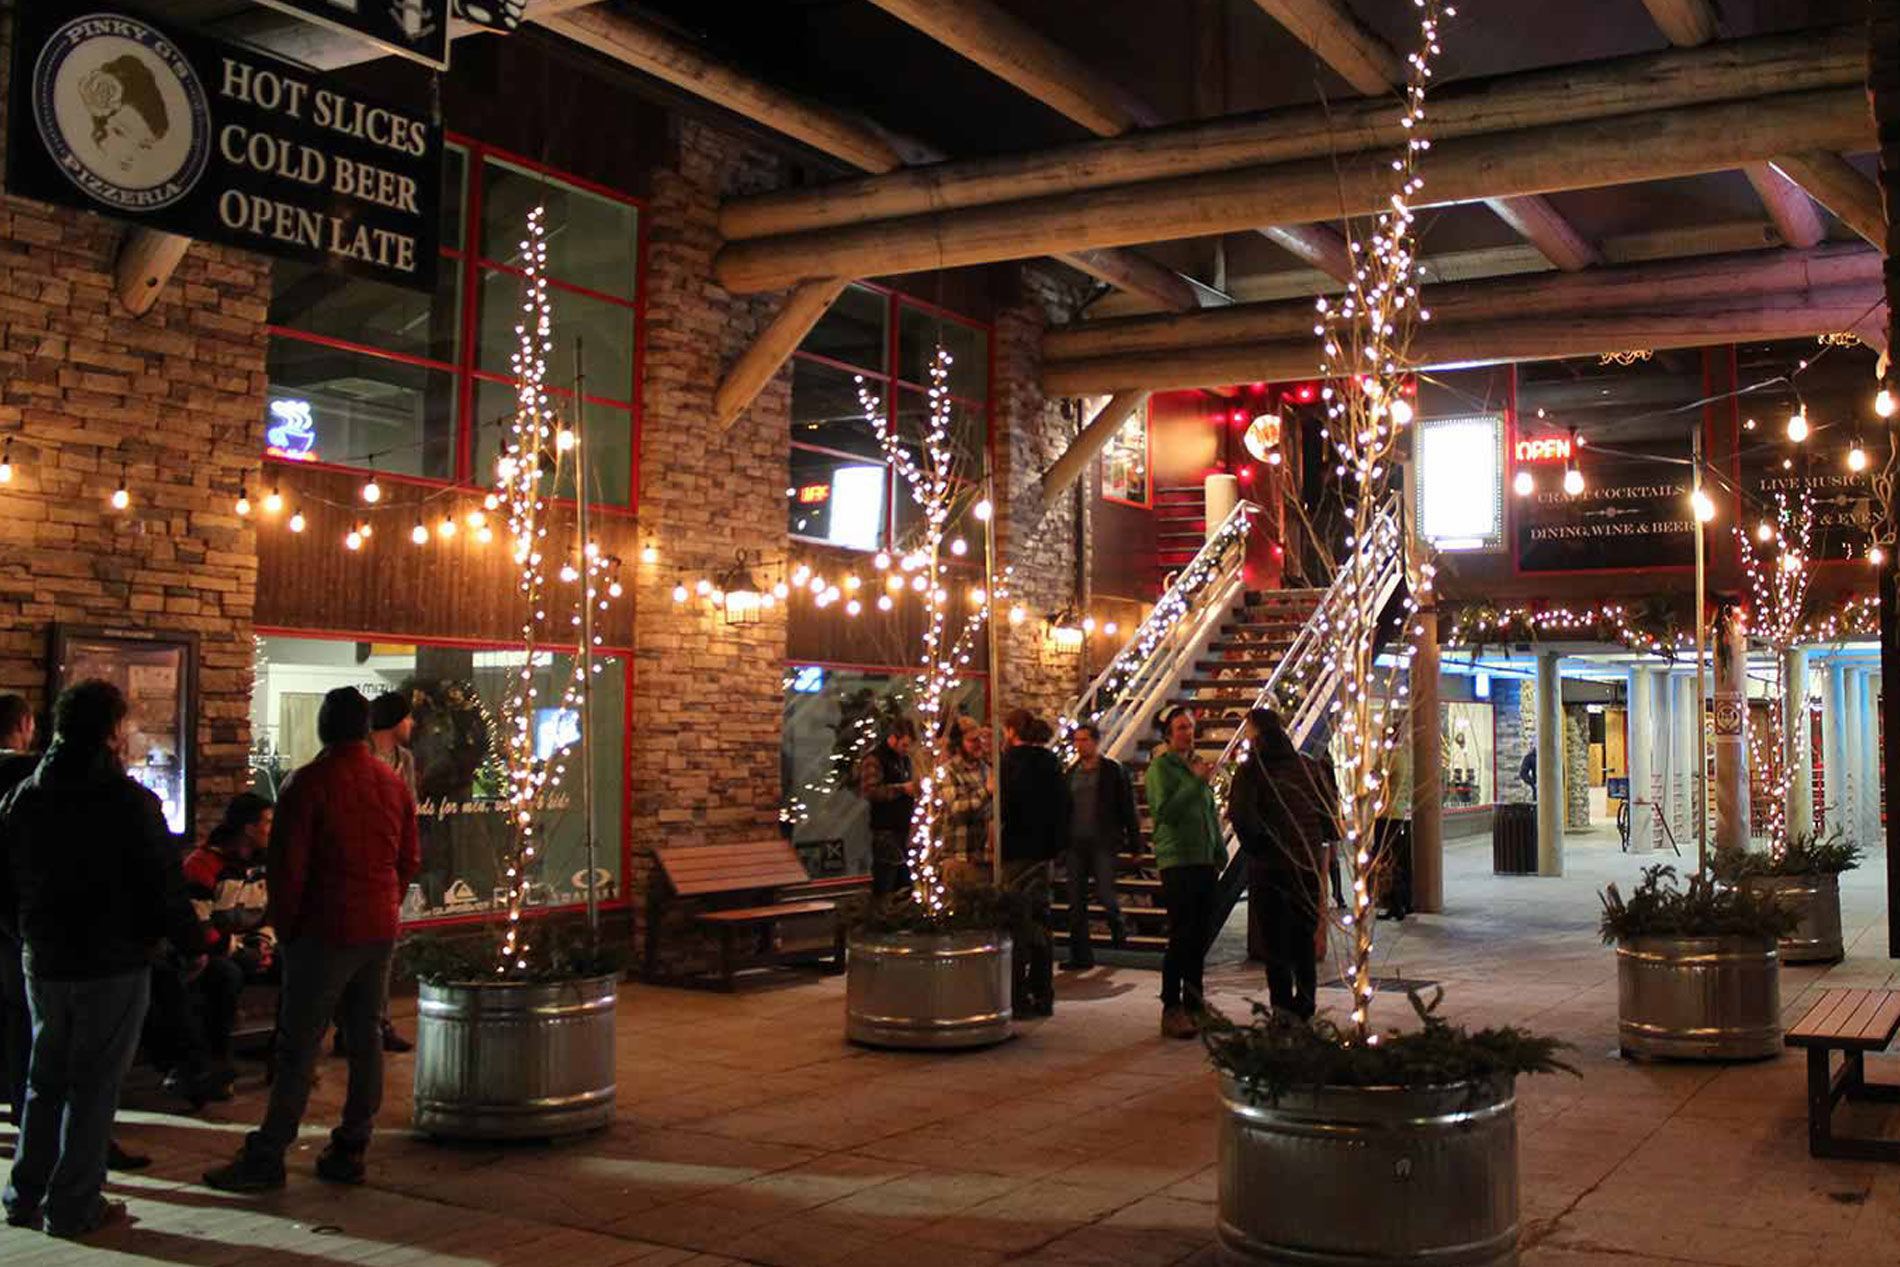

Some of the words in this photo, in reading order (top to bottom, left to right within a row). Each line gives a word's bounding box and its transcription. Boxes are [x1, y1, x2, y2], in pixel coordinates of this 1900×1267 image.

[64, 19, 149, 44] PINKY
[220, 57, 308, 119] HOT
[312, 89, 428, 158] SLICES
[60, 152, 183, 206] PIZZERIA
[219, 124, 326, 186] COLD
[331, 155, 421, 215] BEER
[218, 189, 324, 250] OPEN
[328, 217, 416, 273] LATE
[1594, 485, 1686, 499] COCKTAILS
[1760, 478, 1800, 491] LIVE
[1591, 523, 1635, 536] WINE
[1636, 522, 1650, 534] &
[1652, 520, 1697, 534] BEER
